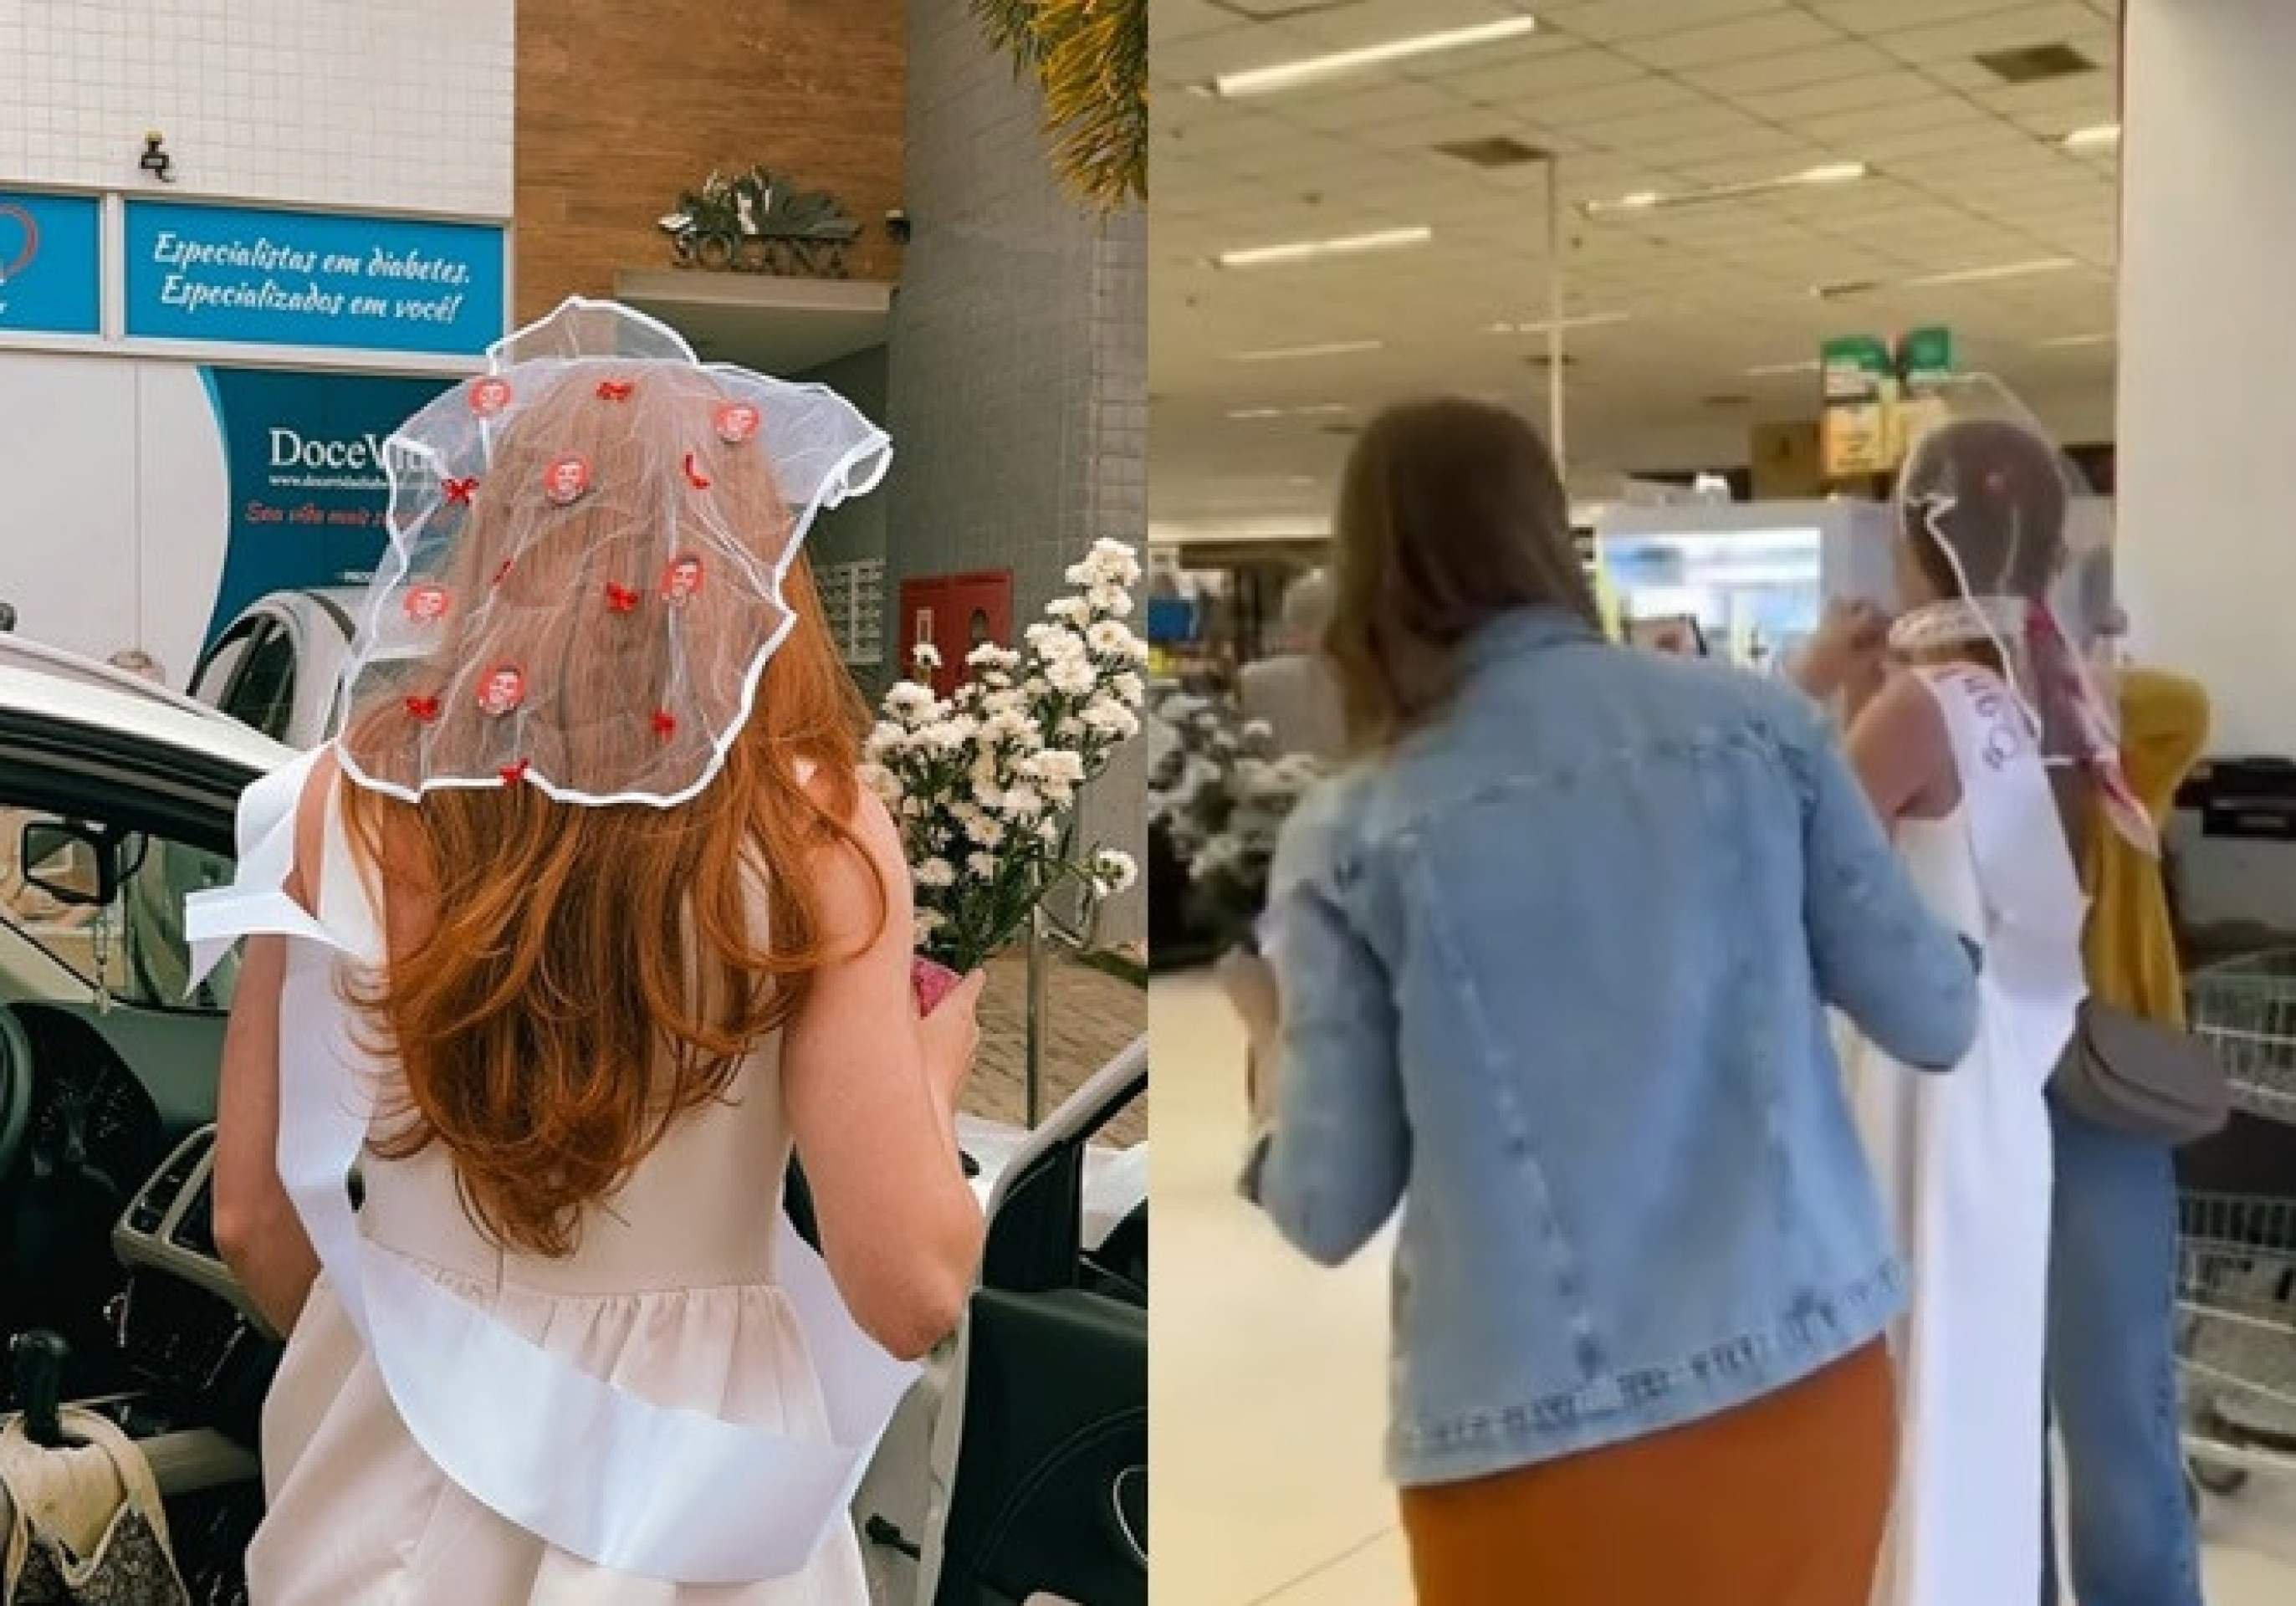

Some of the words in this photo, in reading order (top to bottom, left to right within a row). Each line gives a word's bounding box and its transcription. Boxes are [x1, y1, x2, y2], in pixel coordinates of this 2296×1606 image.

[154, 232, 315, 273] Especialistas
[323, 254, 361, 275] em
[368, 246, 469, 284] diabetes.
[161, 275, 344, 316] Especializados
[350, 296, 387, 317] em
